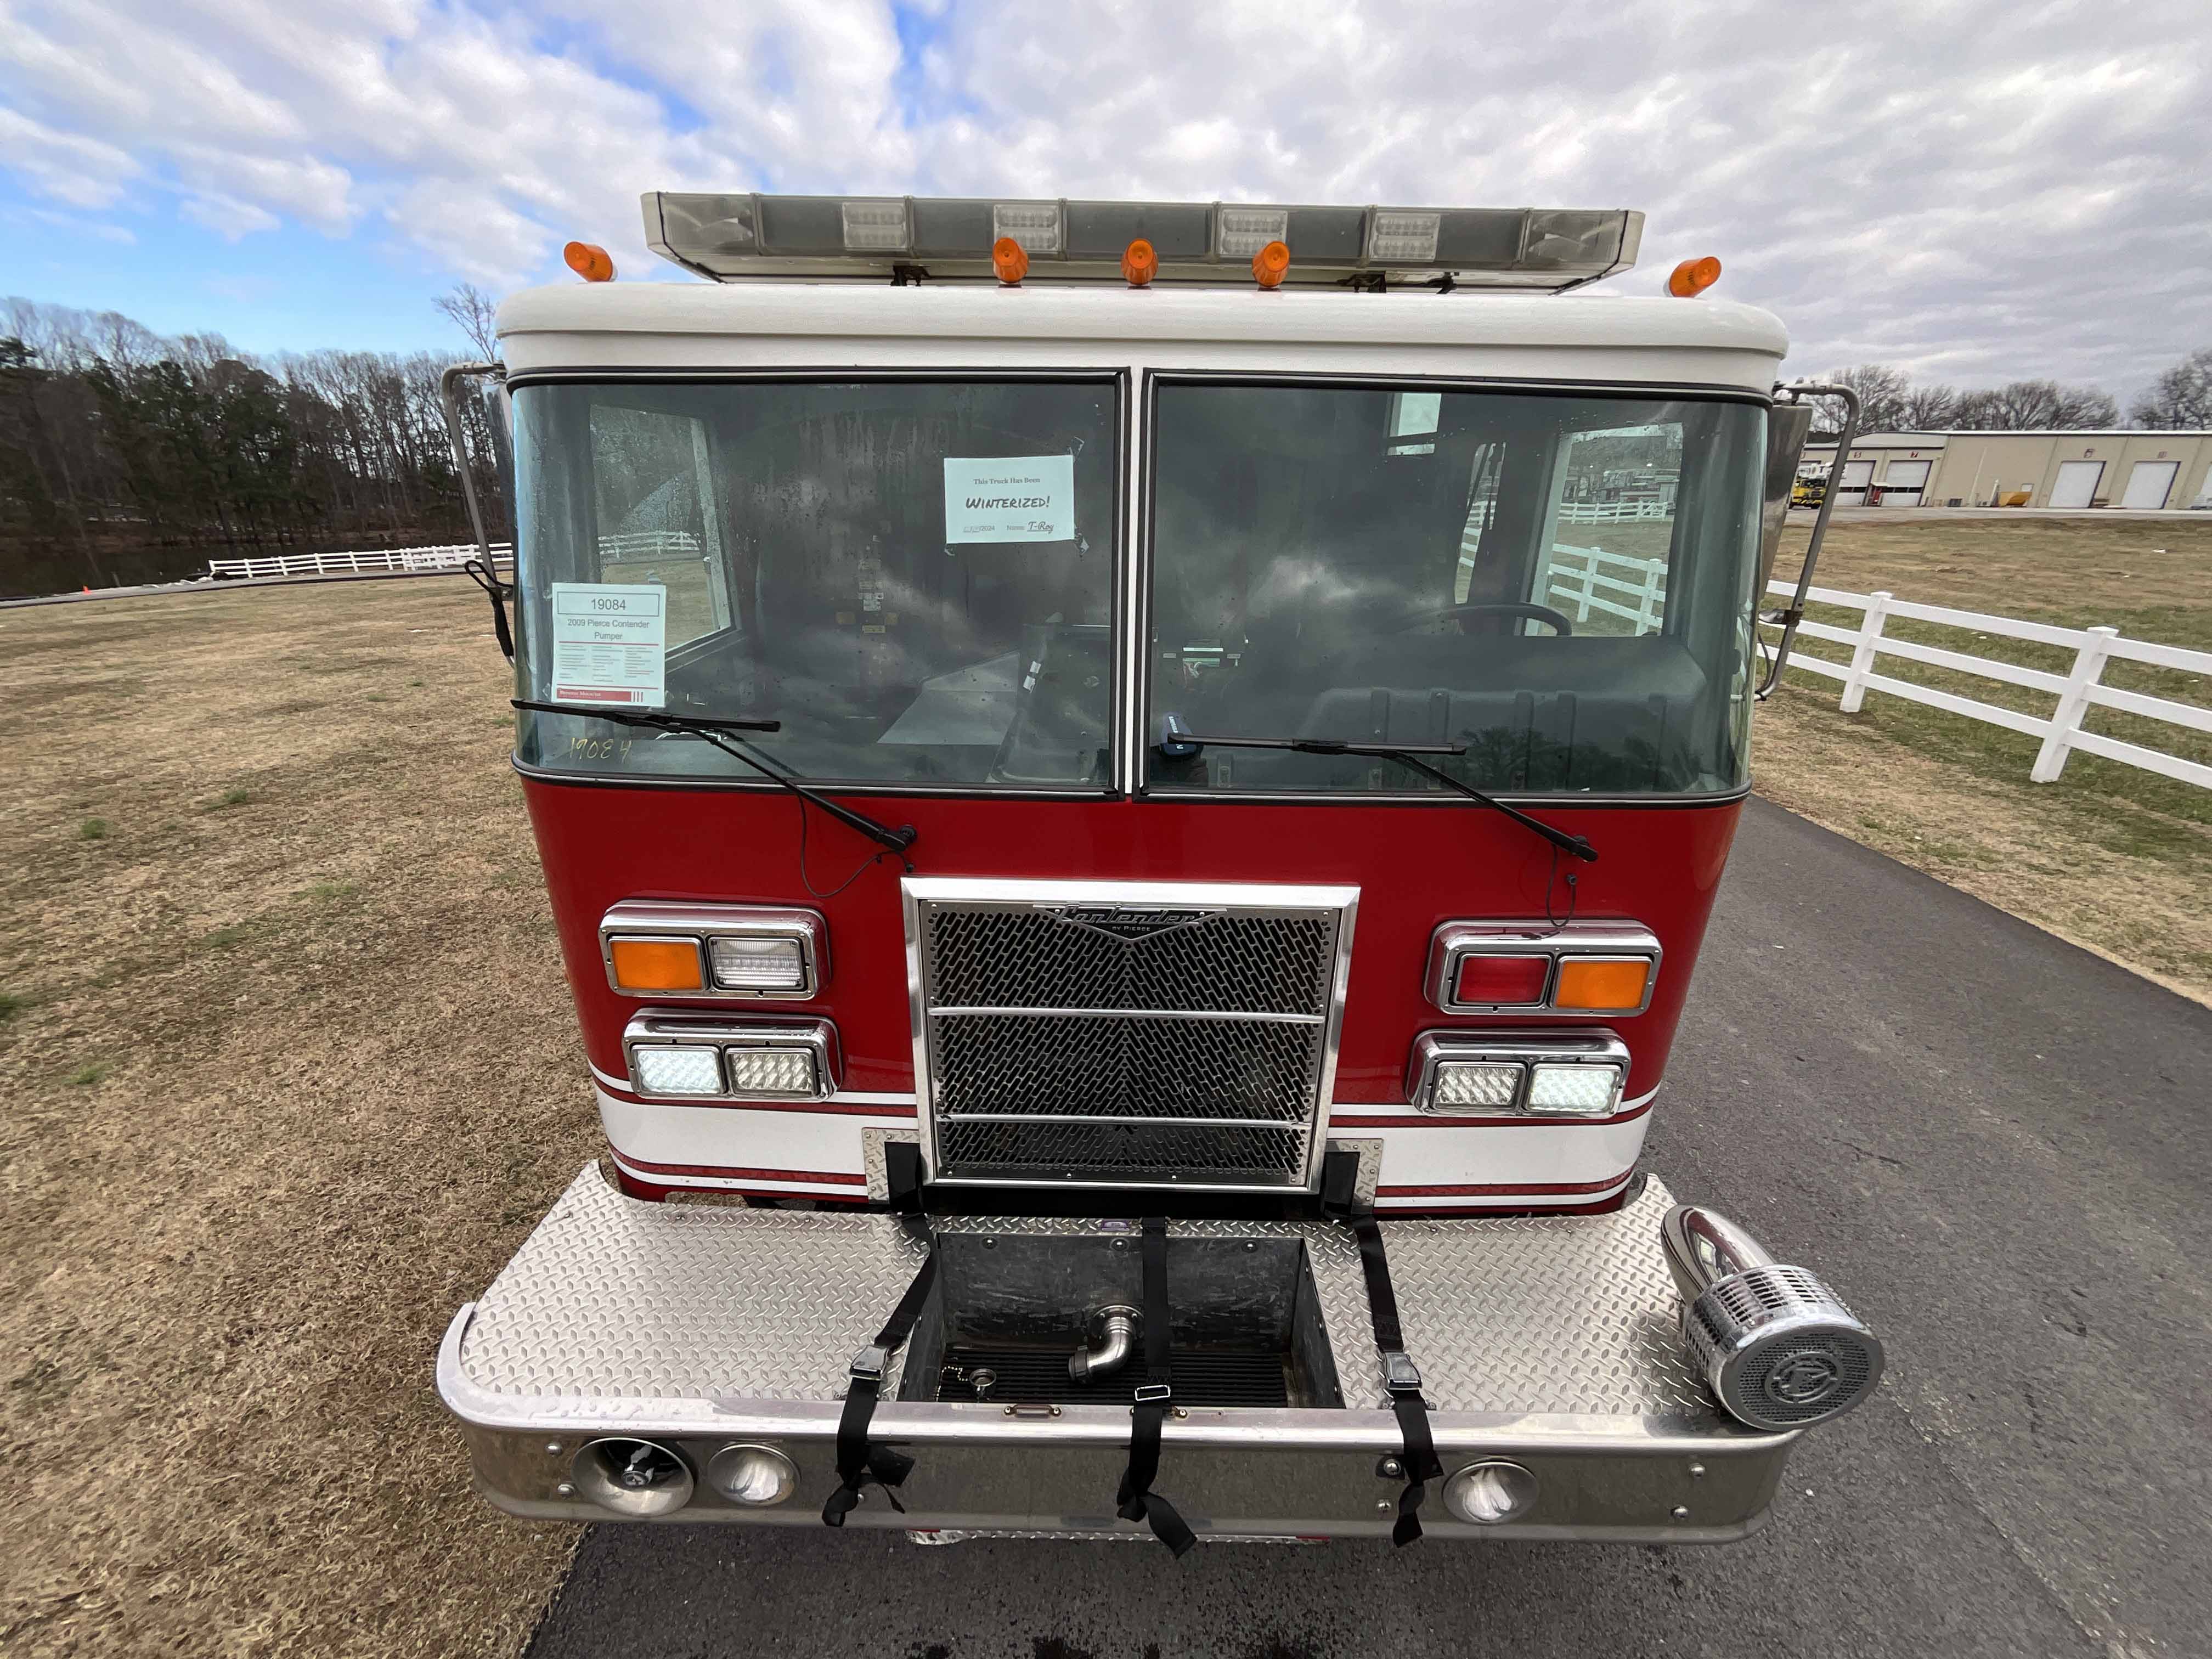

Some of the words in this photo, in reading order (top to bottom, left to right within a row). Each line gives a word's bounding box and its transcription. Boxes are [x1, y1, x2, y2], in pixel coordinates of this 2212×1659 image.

[591, 599, 627, 611] 19084
[567, 618, 585, 627] 2009
[588, 619, 610, 628] Pierce
[612, 619, 650, 629] Contender
[594, 631, 623, 641] Pumper
